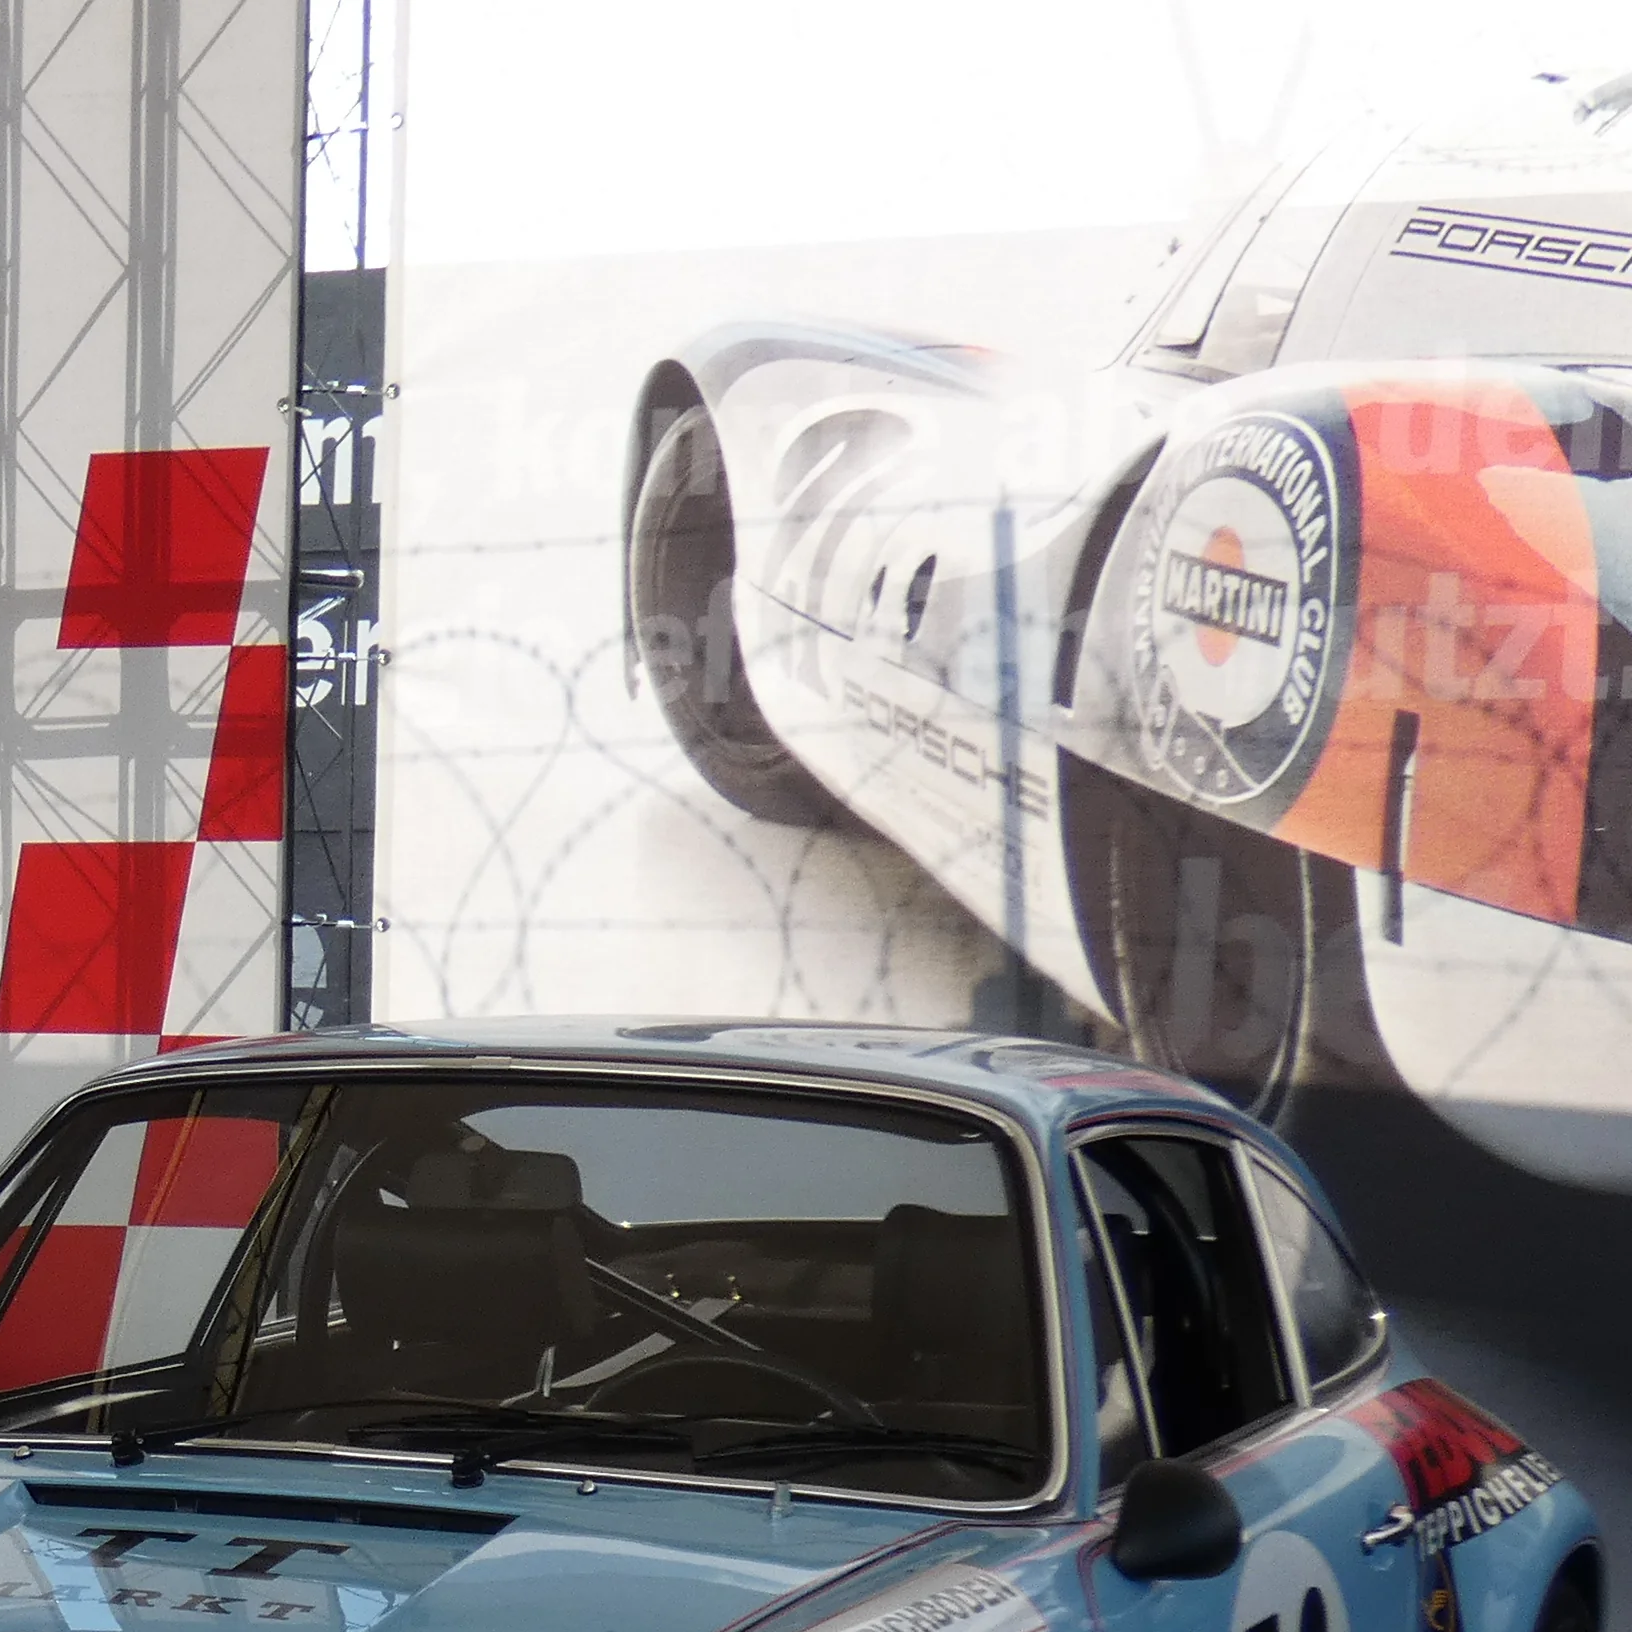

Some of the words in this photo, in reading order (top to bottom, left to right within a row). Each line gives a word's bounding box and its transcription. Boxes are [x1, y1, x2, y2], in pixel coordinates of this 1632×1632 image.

[1394, 216, 1632, 274] PORSC
[1168, 556, 1287, 640] MARTINI
[1281, 596, 1325, 728] CLUB
